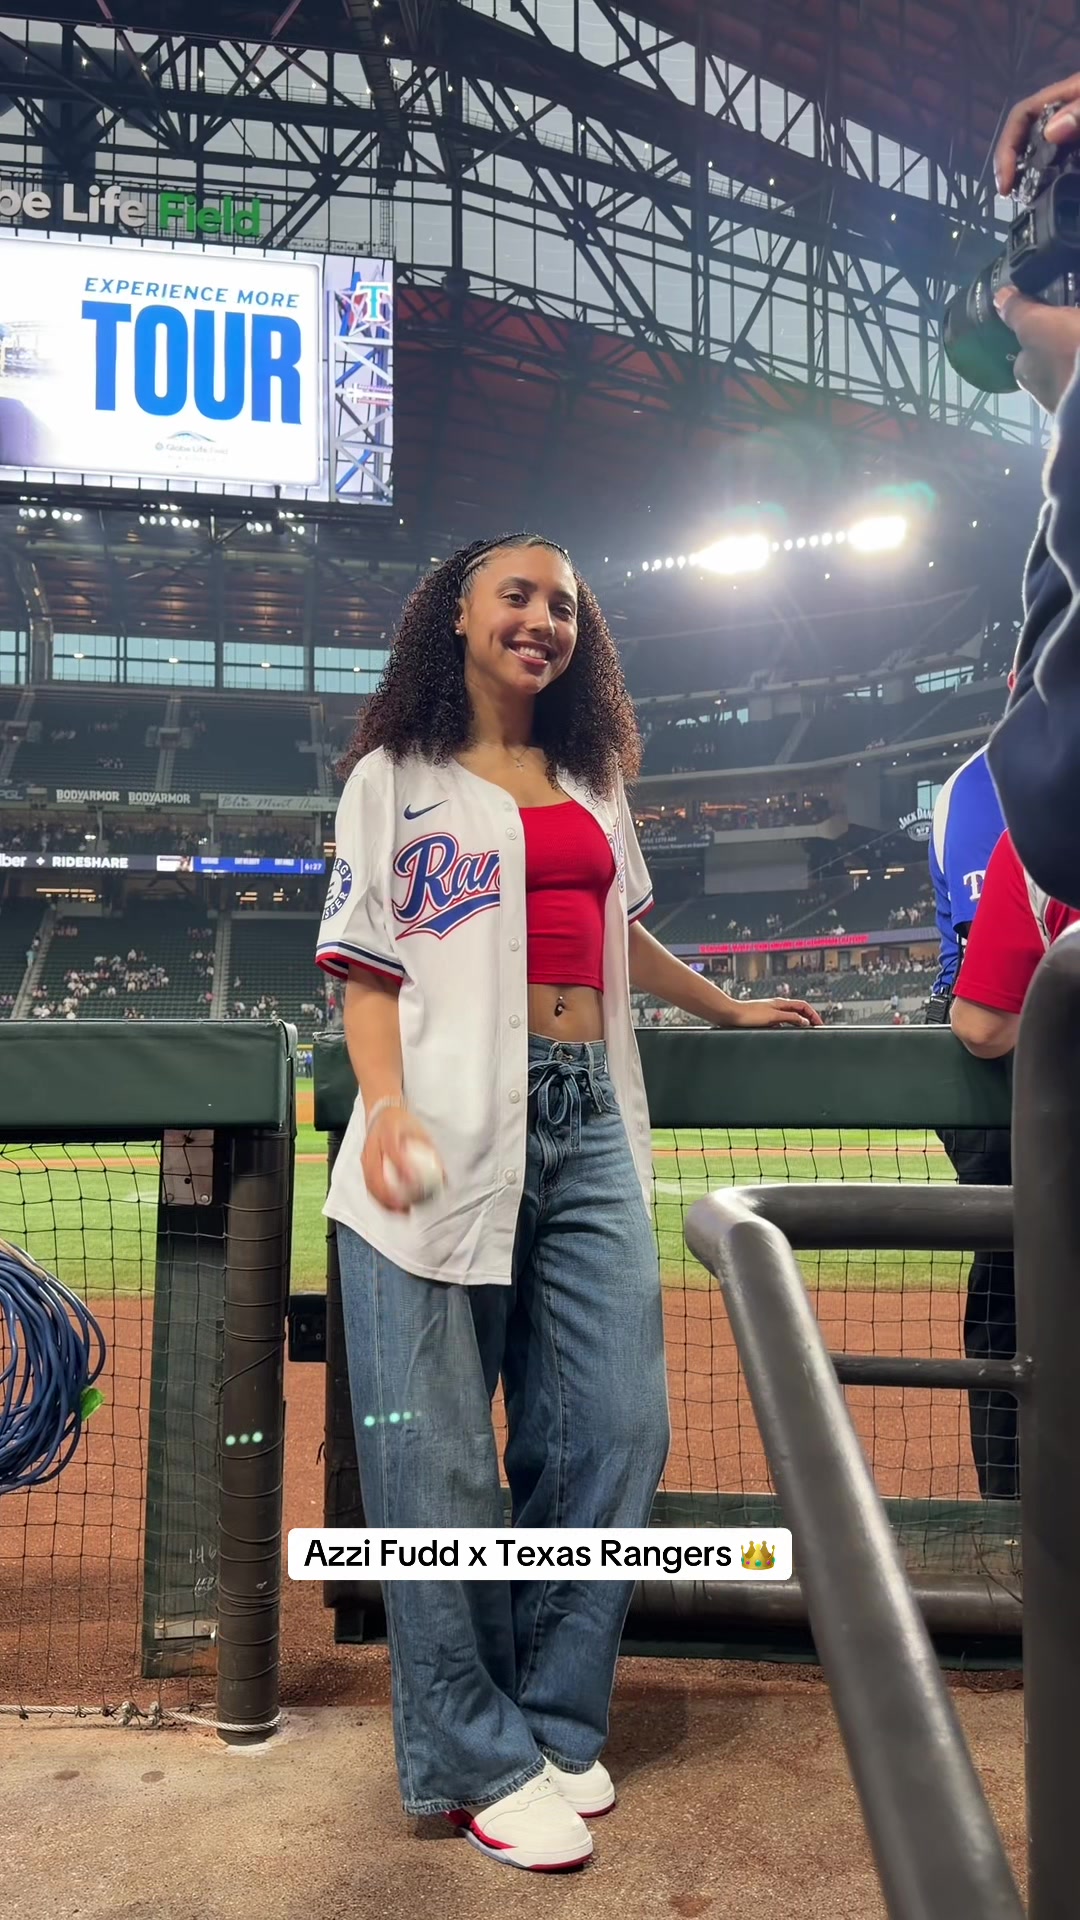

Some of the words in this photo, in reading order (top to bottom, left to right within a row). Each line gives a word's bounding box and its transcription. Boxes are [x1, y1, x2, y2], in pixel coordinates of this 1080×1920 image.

[63, 183, 147, 228] Life
[158, 191, 262, 238] Field
[84, 277, 229, 303] EXPERIENCE
[236, 289, 300, 309] MORE
[81, 300, 302, 425] TOUR
[56, 789, 120, 802] BODYARMOR
[128, 791, 191, 804] BODYARMOR
[52, 856, 129, 869] RIDESHARE
